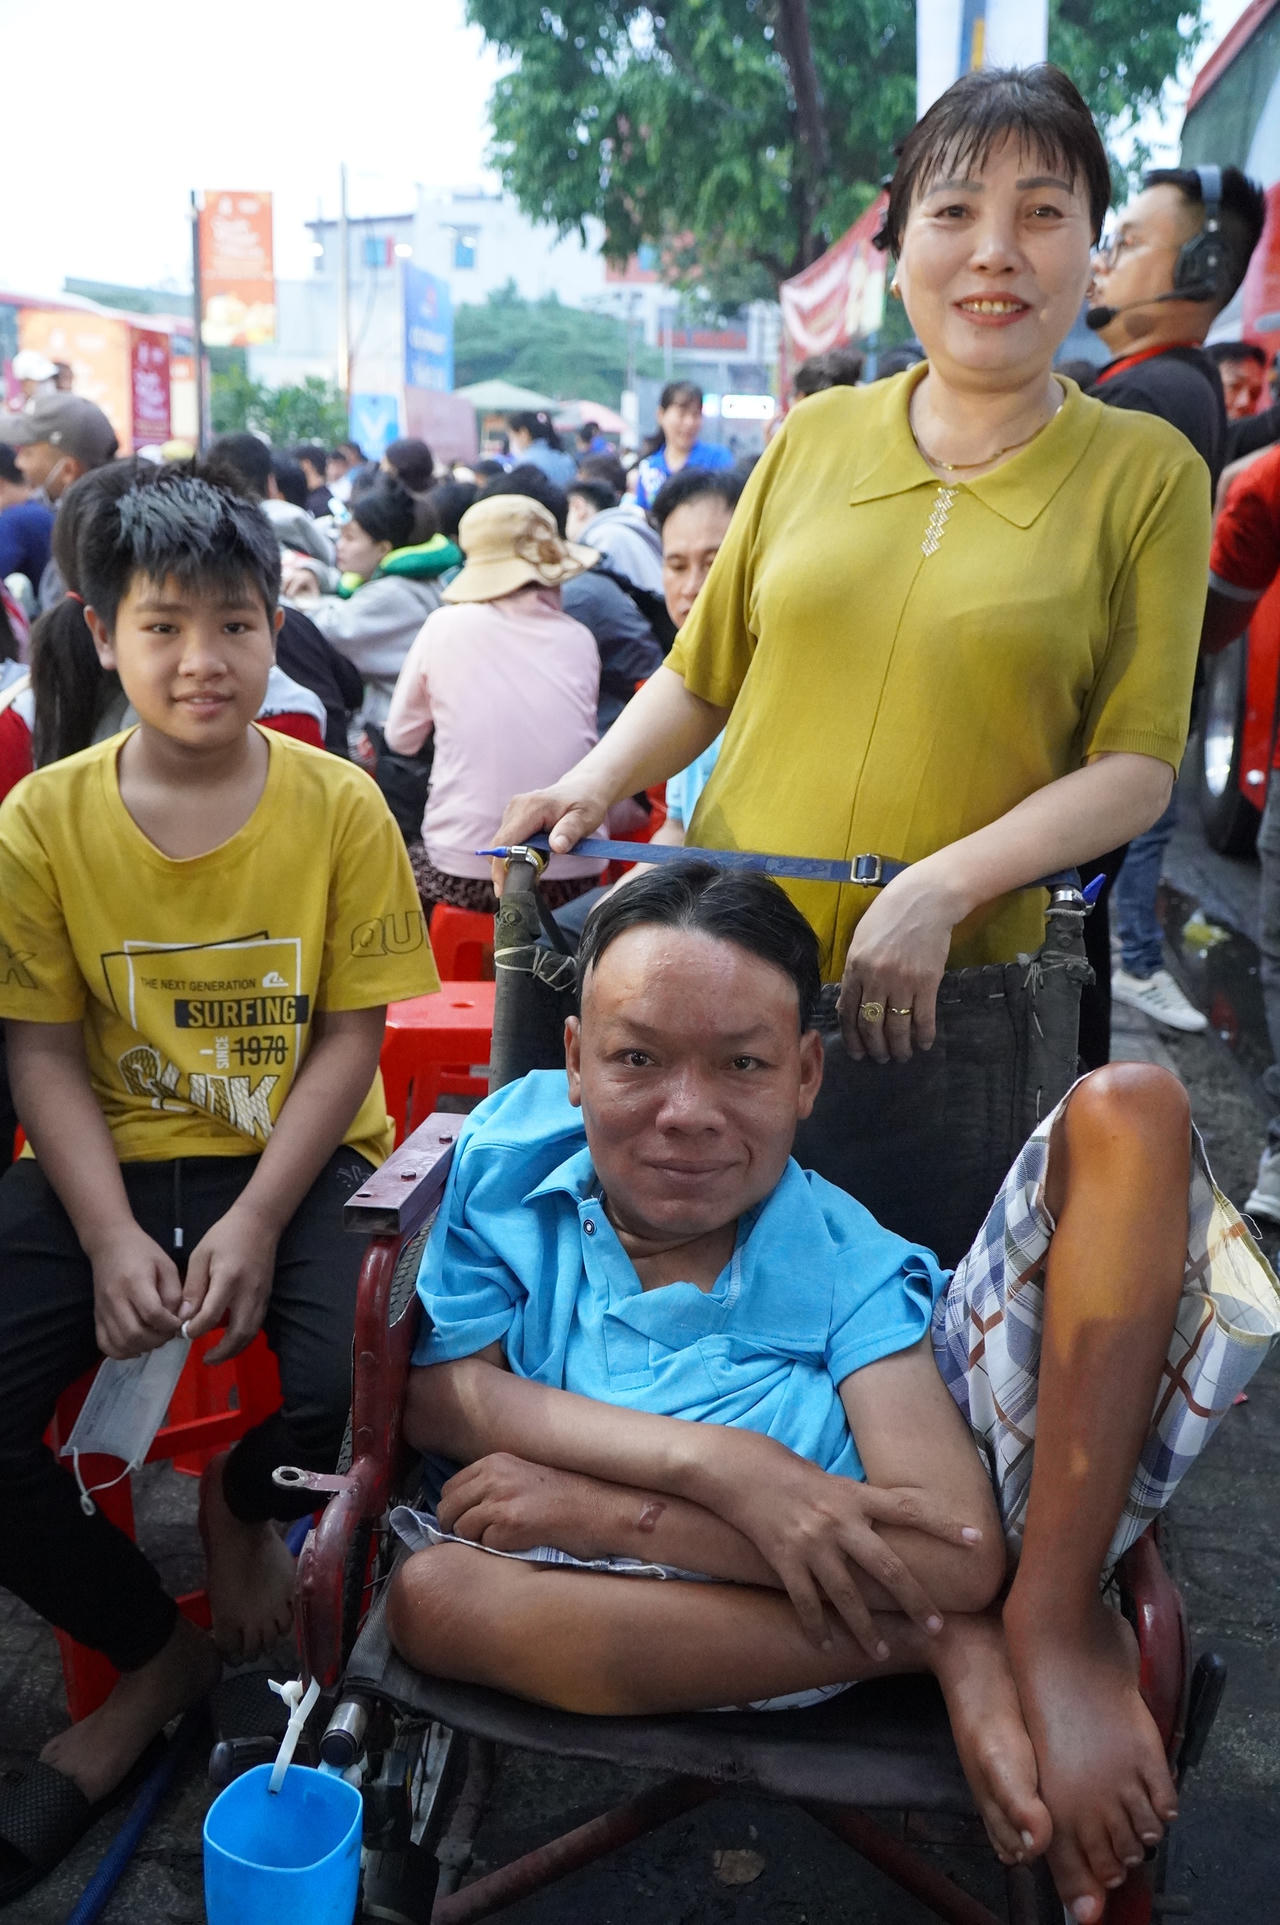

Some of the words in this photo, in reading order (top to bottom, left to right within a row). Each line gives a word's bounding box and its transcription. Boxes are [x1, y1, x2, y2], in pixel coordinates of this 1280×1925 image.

[351, 910, 431, 957] QU
[140, 977, 158, 990] THE
[160, 979, 186, 991] NEXT
[189, 978, 256, 991] GENERATION
[187, 997, 297, 1028] SURFING
[215, 1035, 230, 1070] SINCE
[231, 1035, 287, 1066] 1978
